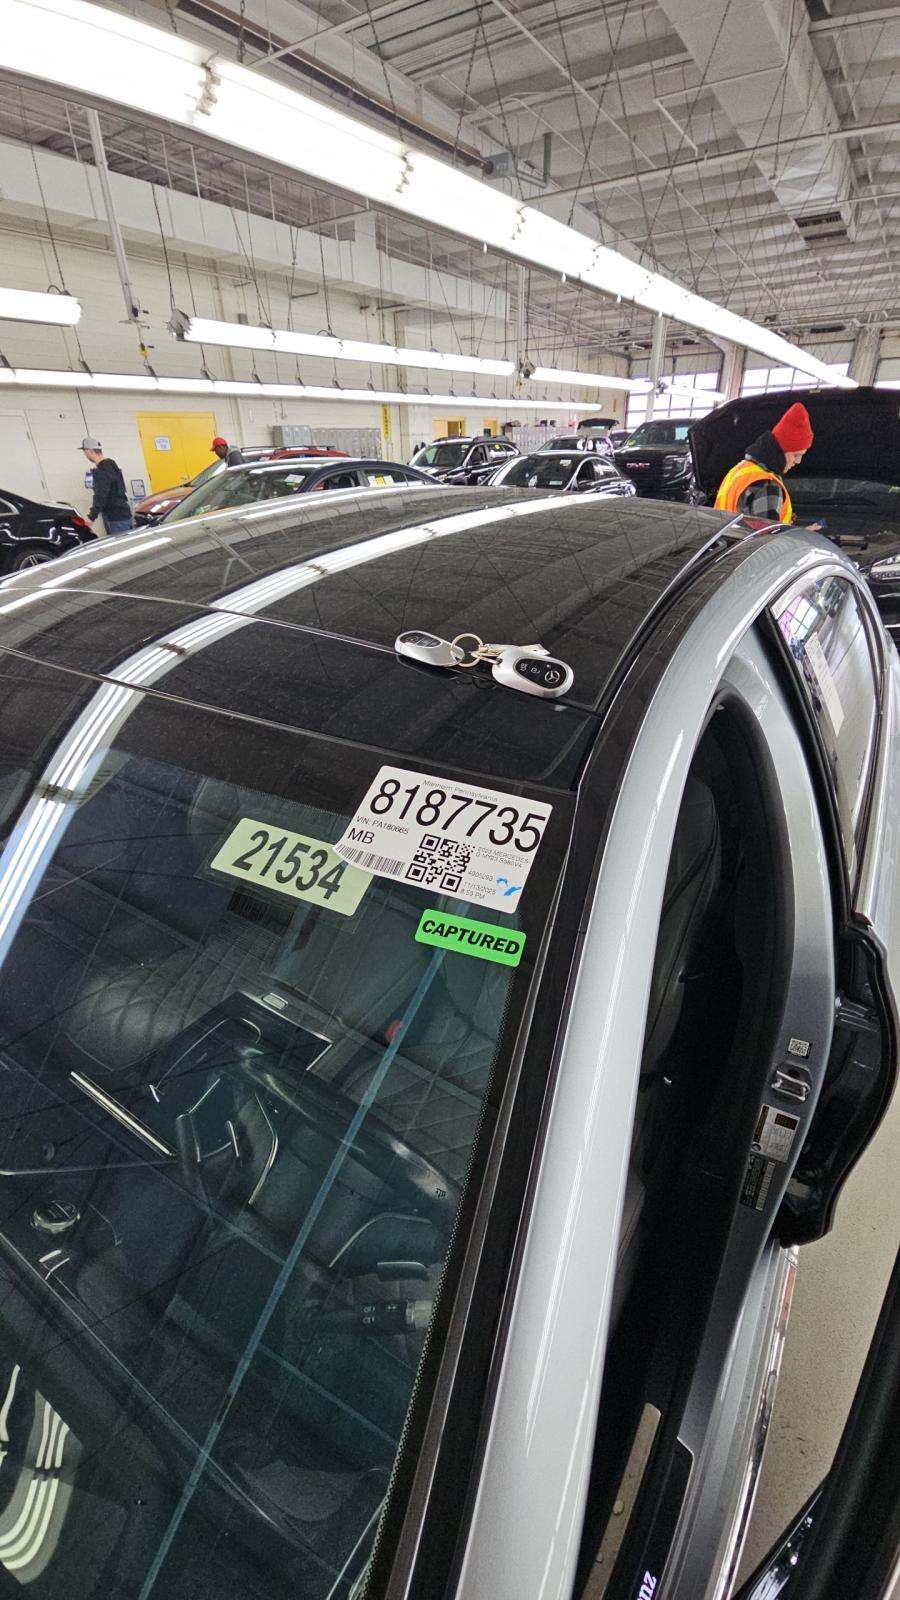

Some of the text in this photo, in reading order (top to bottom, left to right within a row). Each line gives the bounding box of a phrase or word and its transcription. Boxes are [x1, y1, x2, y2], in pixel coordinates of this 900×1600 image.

[347, 827, 375, 844] MB
[370, 778, 546, 853] 8187735
[232, 830, 342, 900] 21534
[421, 919, 520, 956] CAPTURED
